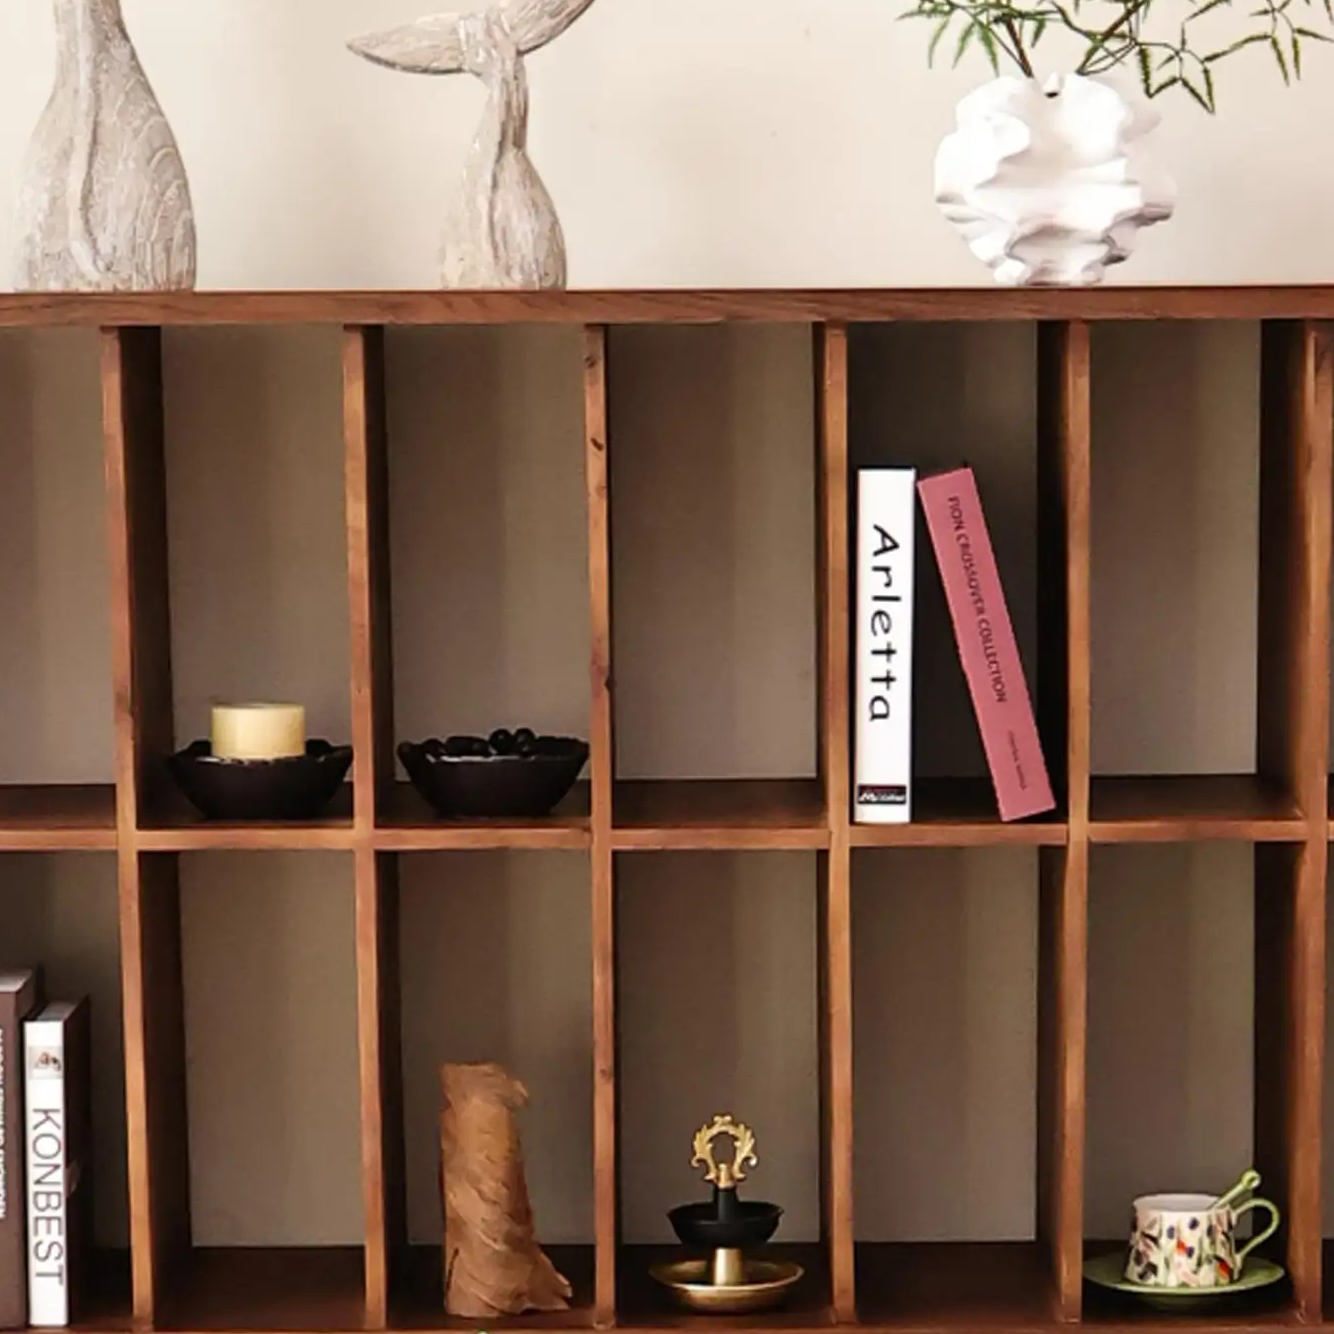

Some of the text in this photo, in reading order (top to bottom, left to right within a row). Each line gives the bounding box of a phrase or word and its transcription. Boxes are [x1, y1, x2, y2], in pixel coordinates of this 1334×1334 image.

[868, 523, 902, 722] Arletta
[975, 617, 1008, 704] COLLECTION
[31, 1107, 64, 1286] KONBEST
